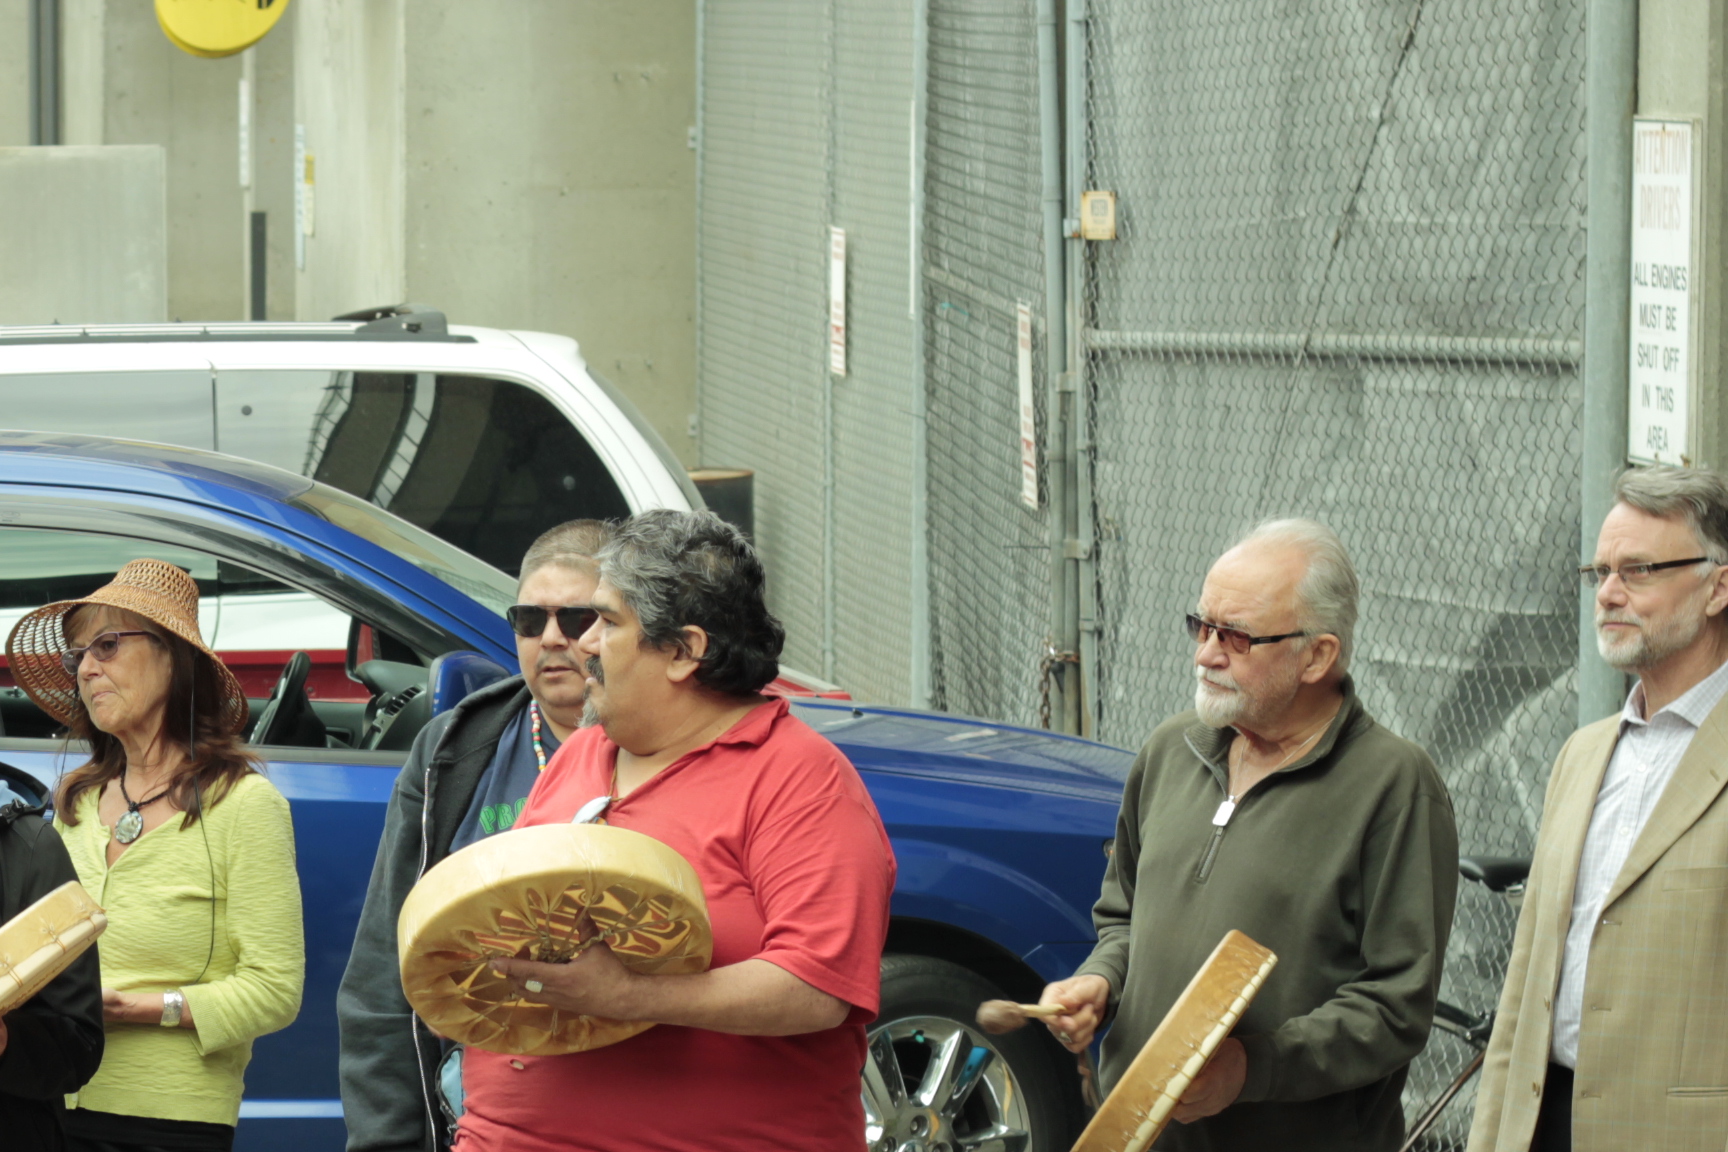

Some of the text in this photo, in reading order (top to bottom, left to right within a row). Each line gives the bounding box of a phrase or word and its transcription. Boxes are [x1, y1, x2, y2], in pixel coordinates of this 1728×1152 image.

[1635, 130, 1688, 174] ATTENTION
[1640, 184, 1681, 231] DRIVERS
[1634, 262, 1687, 291] ALL ENGINES
[1639, 303, 1677, 332] MUST BE
[1638, 342, 1680, 373] SHUT OFF
[1642, 383, 1674, 413] IN THIS
[1646, 424, 1669, 452] AREA
